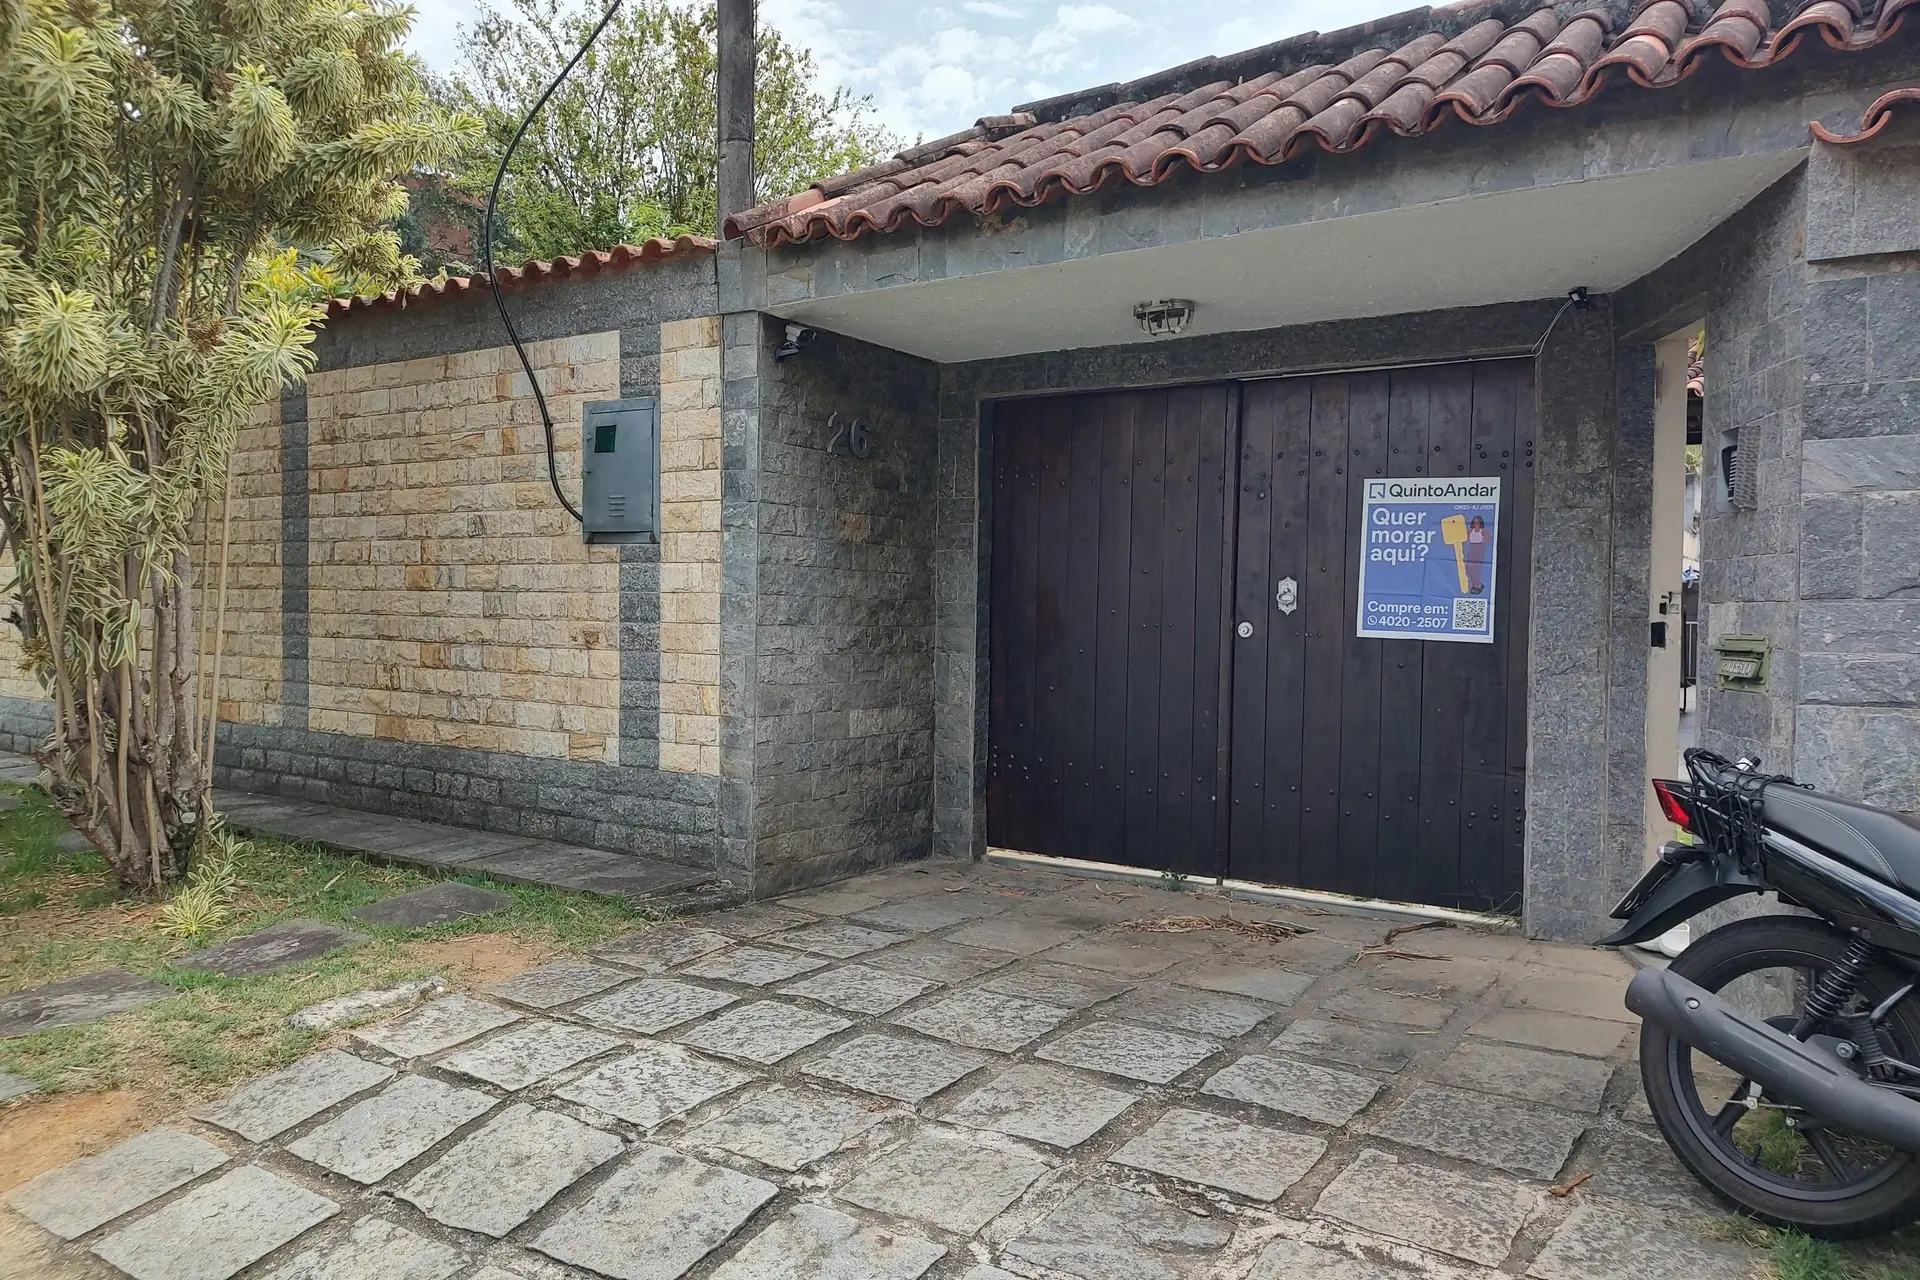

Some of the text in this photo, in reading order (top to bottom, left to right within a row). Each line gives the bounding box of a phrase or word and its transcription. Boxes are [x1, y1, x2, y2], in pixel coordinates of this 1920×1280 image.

[827, 410, 872, 458] 26
[1389, 483, 1497, 498] QuintoAndar
[1372, 507, 1426, 526] Quer
[1371, 529, 1436, 543] morar
[1370, 544, 1429, 566] aqui?
[1367, 600, 1448, 615] Compre em:
[1378, 615, 1448, 628] 4020-2507
